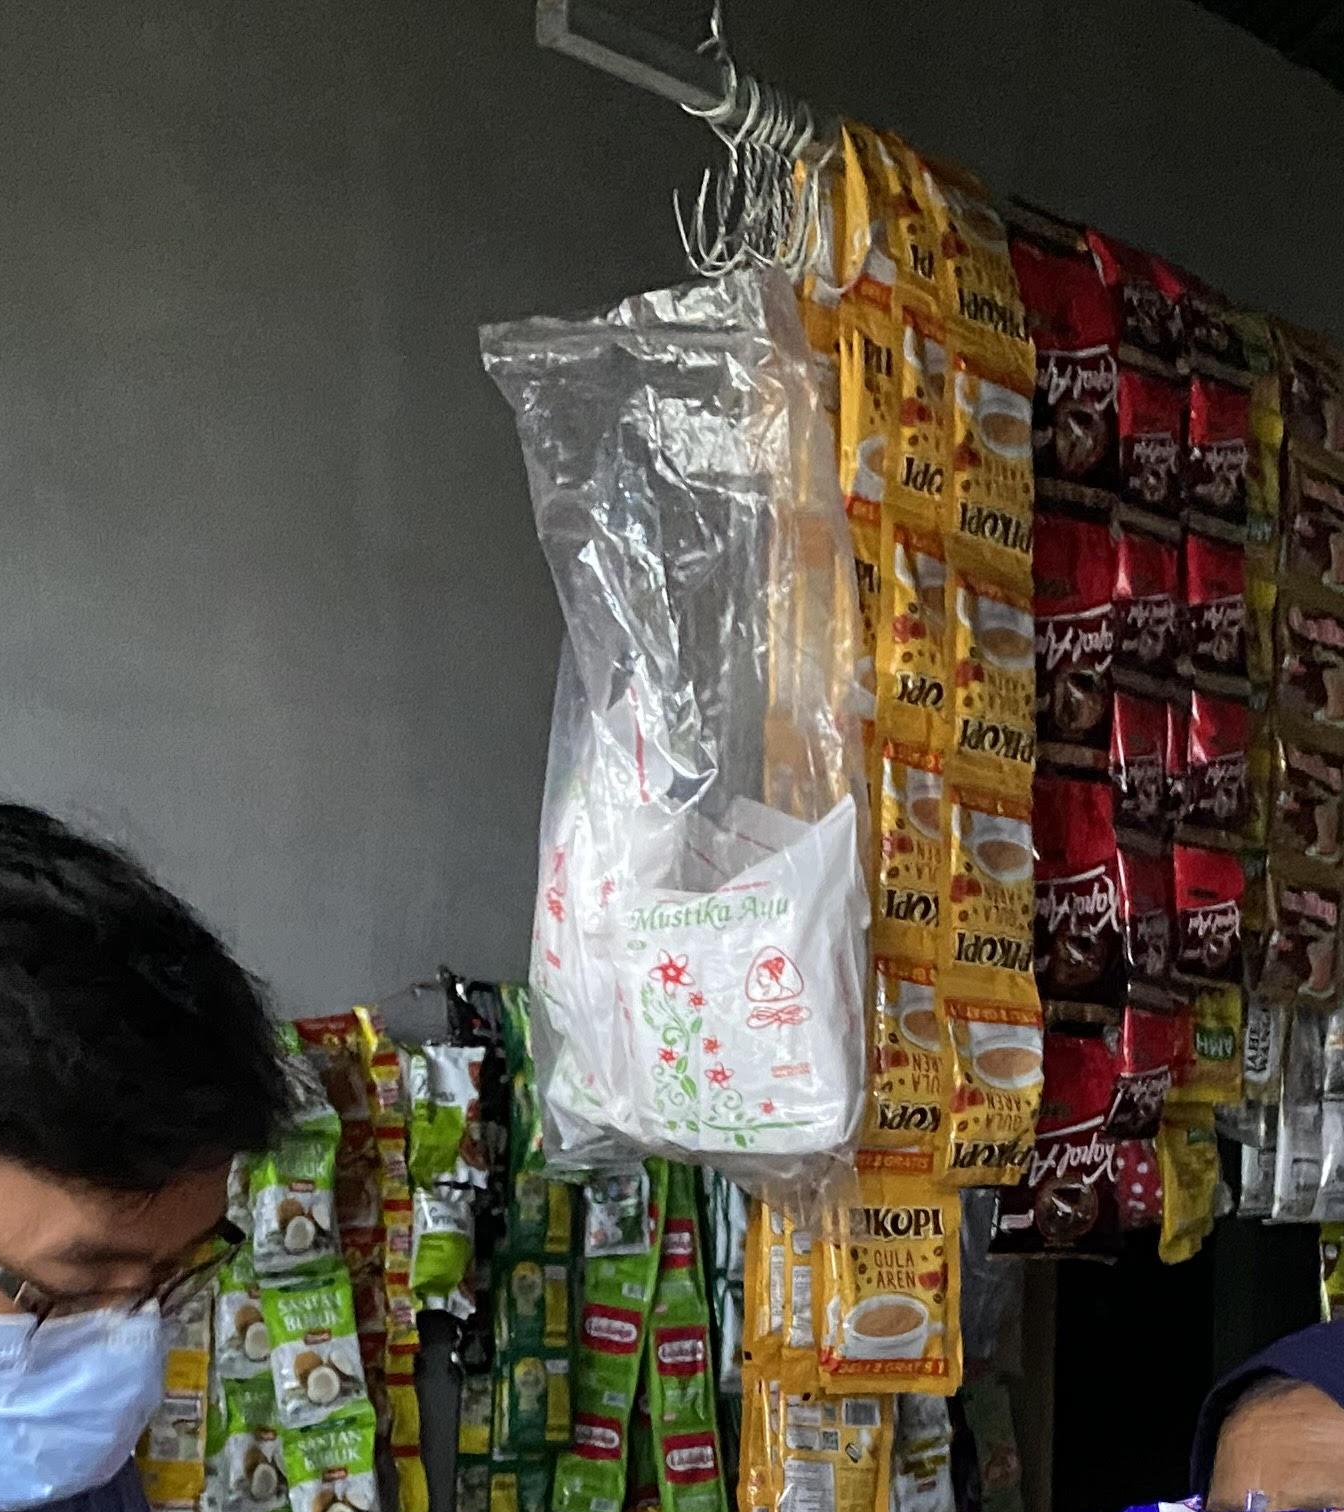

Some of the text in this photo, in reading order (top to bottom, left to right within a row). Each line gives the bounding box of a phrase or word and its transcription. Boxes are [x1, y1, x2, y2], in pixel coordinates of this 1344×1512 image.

[631, 894, 733, 932] Mustika
[955, 933, 1033, 972] PIKOPI
[1056, 1132, 1116, 1185] Kapal
[873, 1249, 915, 1269] GULA
[876, 1270, 917, 1290] AREN
